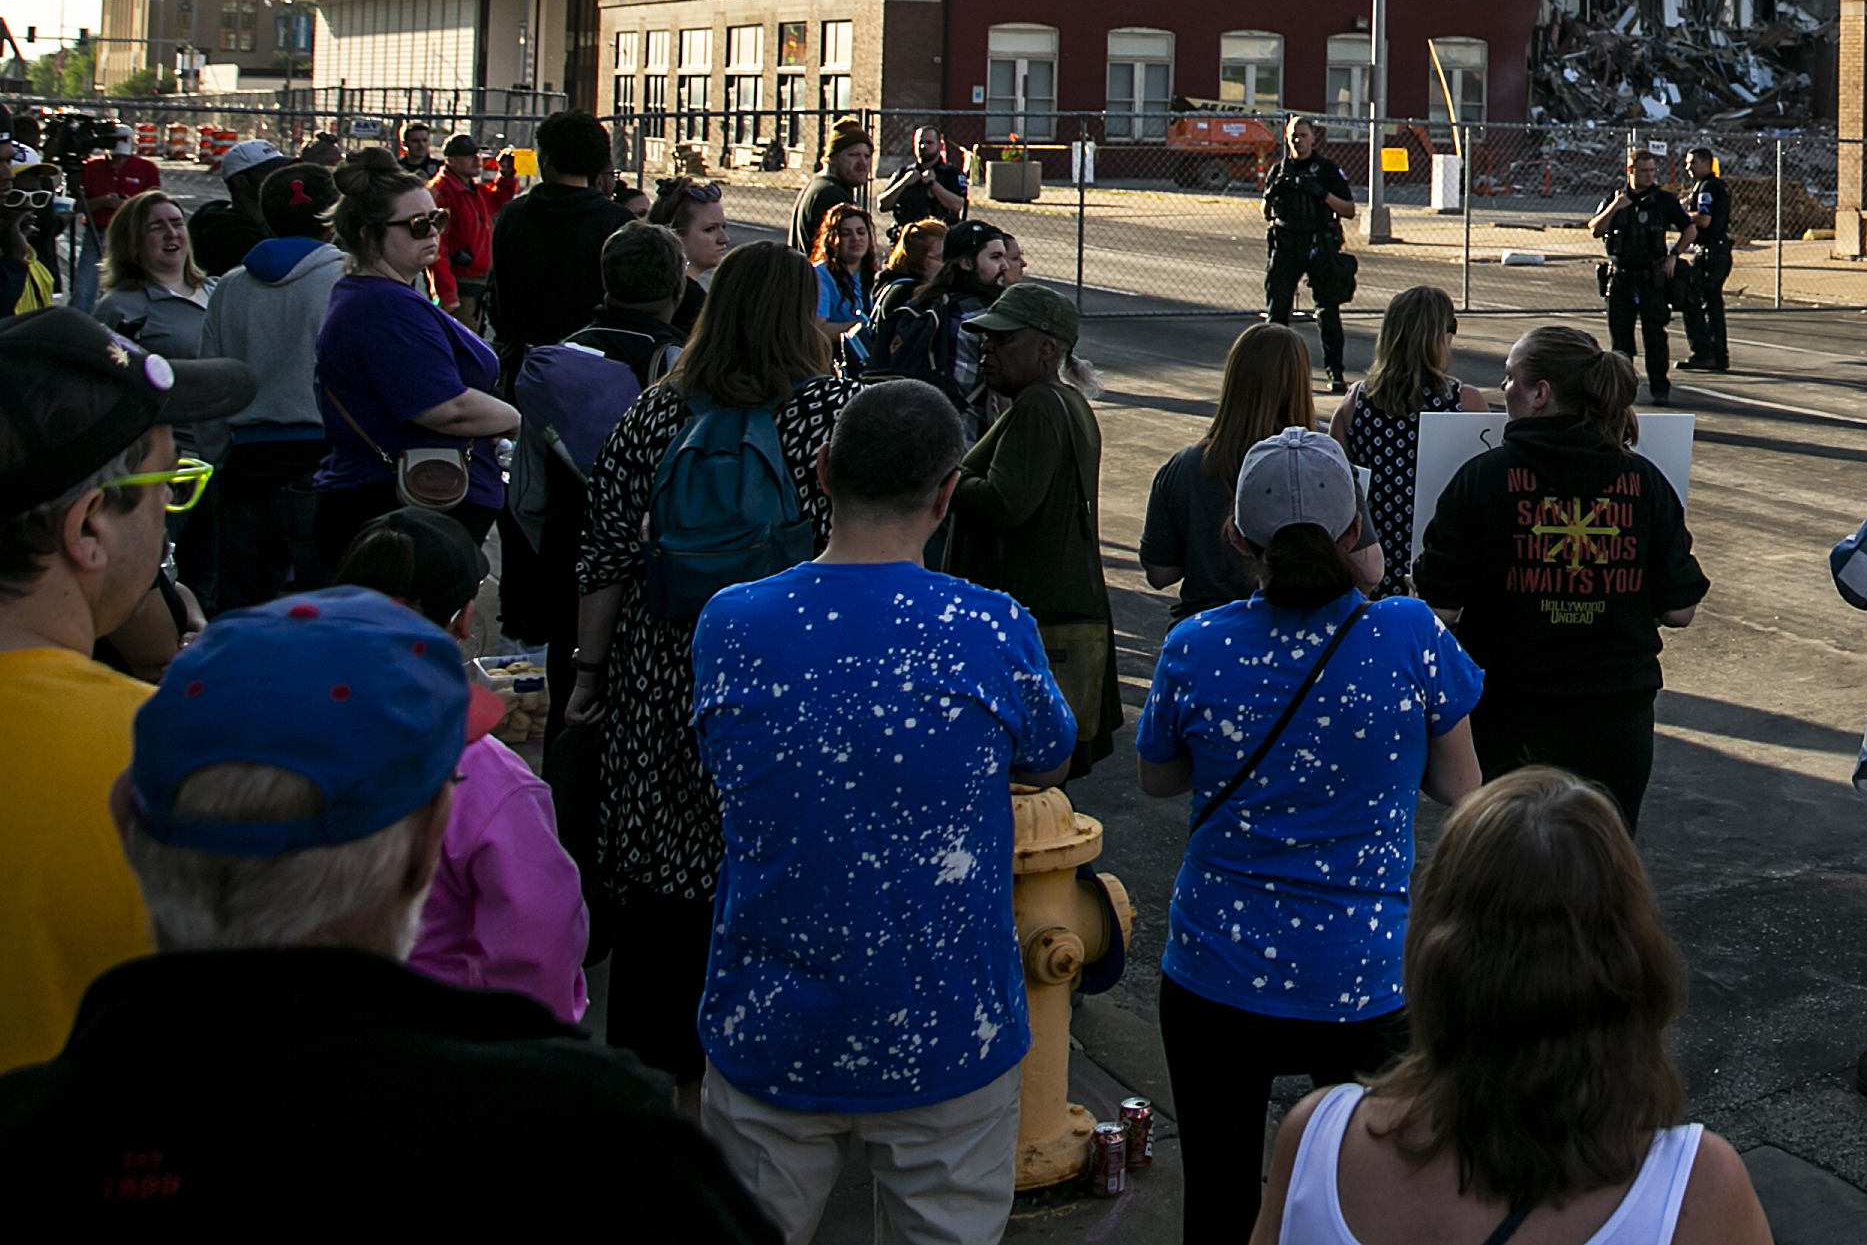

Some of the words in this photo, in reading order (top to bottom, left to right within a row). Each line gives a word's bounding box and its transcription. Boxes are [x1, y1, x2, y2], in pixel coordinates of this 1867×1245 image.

[1603, 472, 1641, 497] AN
[1590, 501, 1634, 529] YOU
[1513, 533, 1555, 560] THE
[1506, 566, 1594, 595] AWAITS
[1602, 568, 1643, 594] YOU
[1540, 599, 1606, 614] HOLLYWOOD
[1550, 611, 1594, 625] UNDEAD
